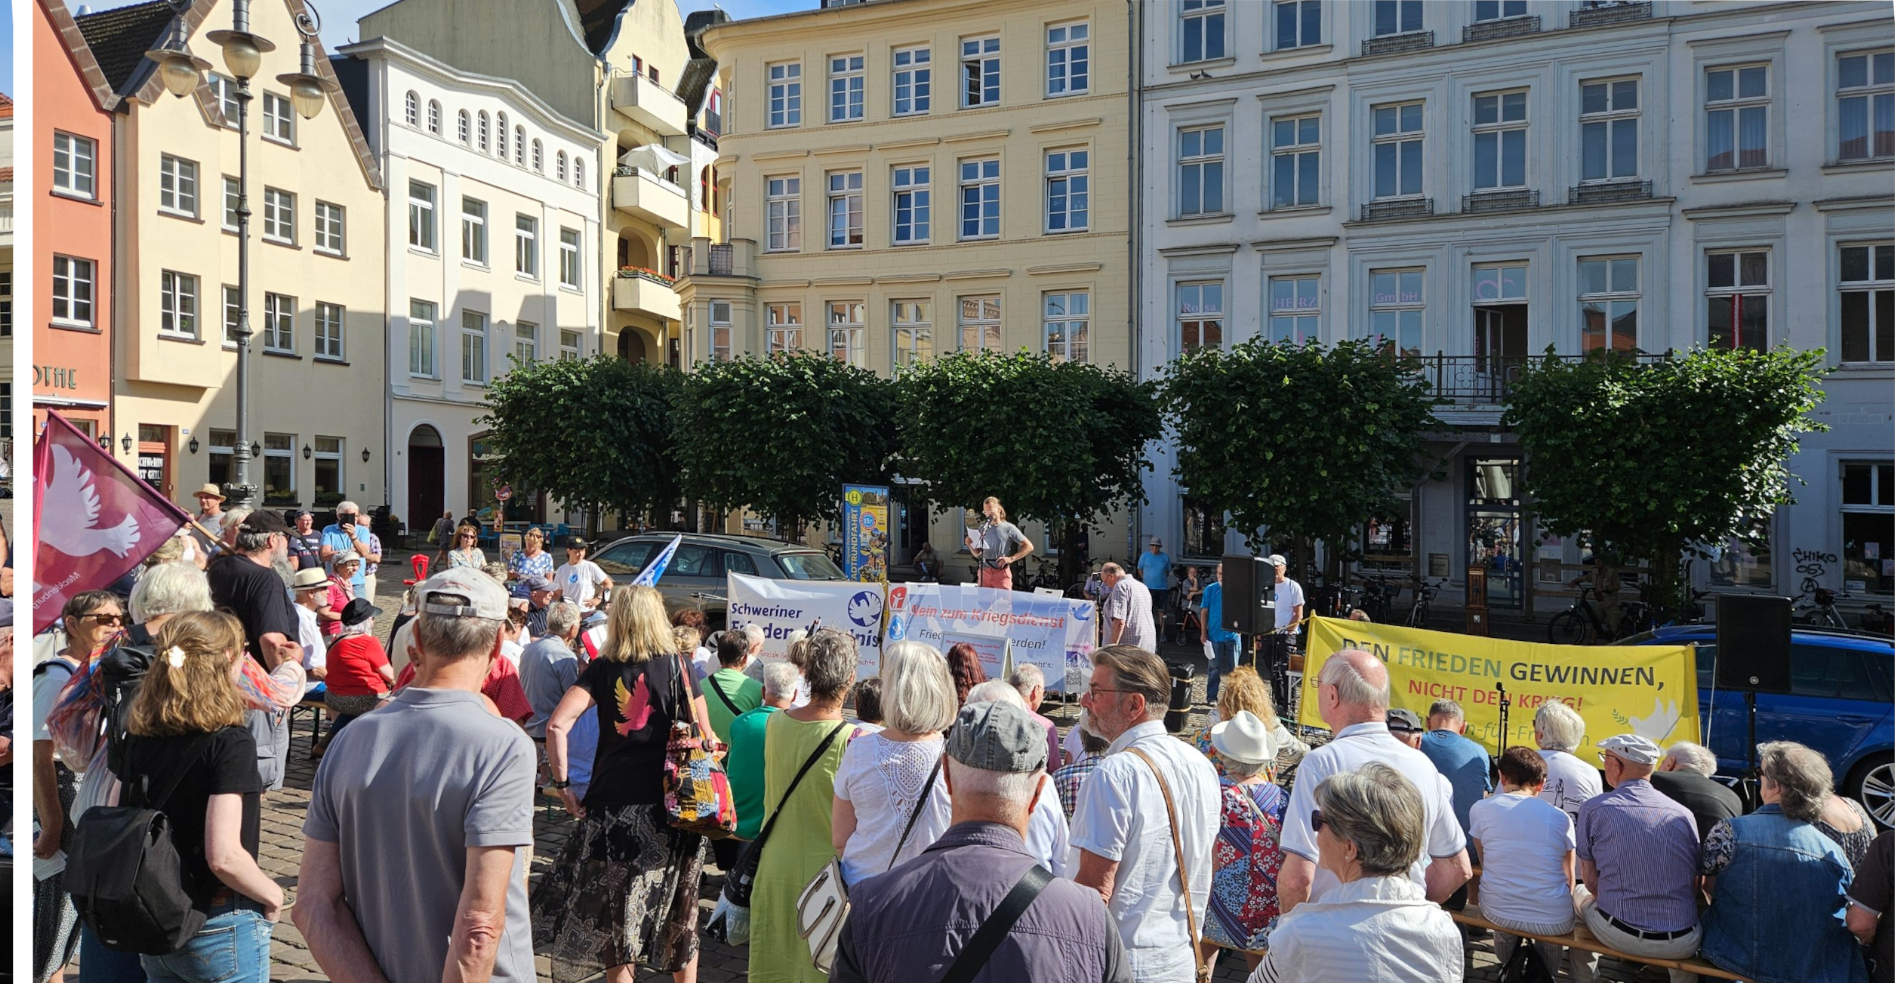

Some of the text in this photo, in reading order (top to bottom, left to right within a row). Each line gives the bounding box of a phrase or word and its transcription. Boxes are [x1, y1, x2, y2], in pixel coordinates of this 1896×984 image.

[731, 602, 803, 619] Schweriner
[910, 604, 1064, 629] Nein zum Kriegsdienst
[1398, 646, 1502, 679] FRIEDEN
[1510, 661, 1665, 692] GEWINNEN,
[1408, 679, 1468, 701] NICHT
